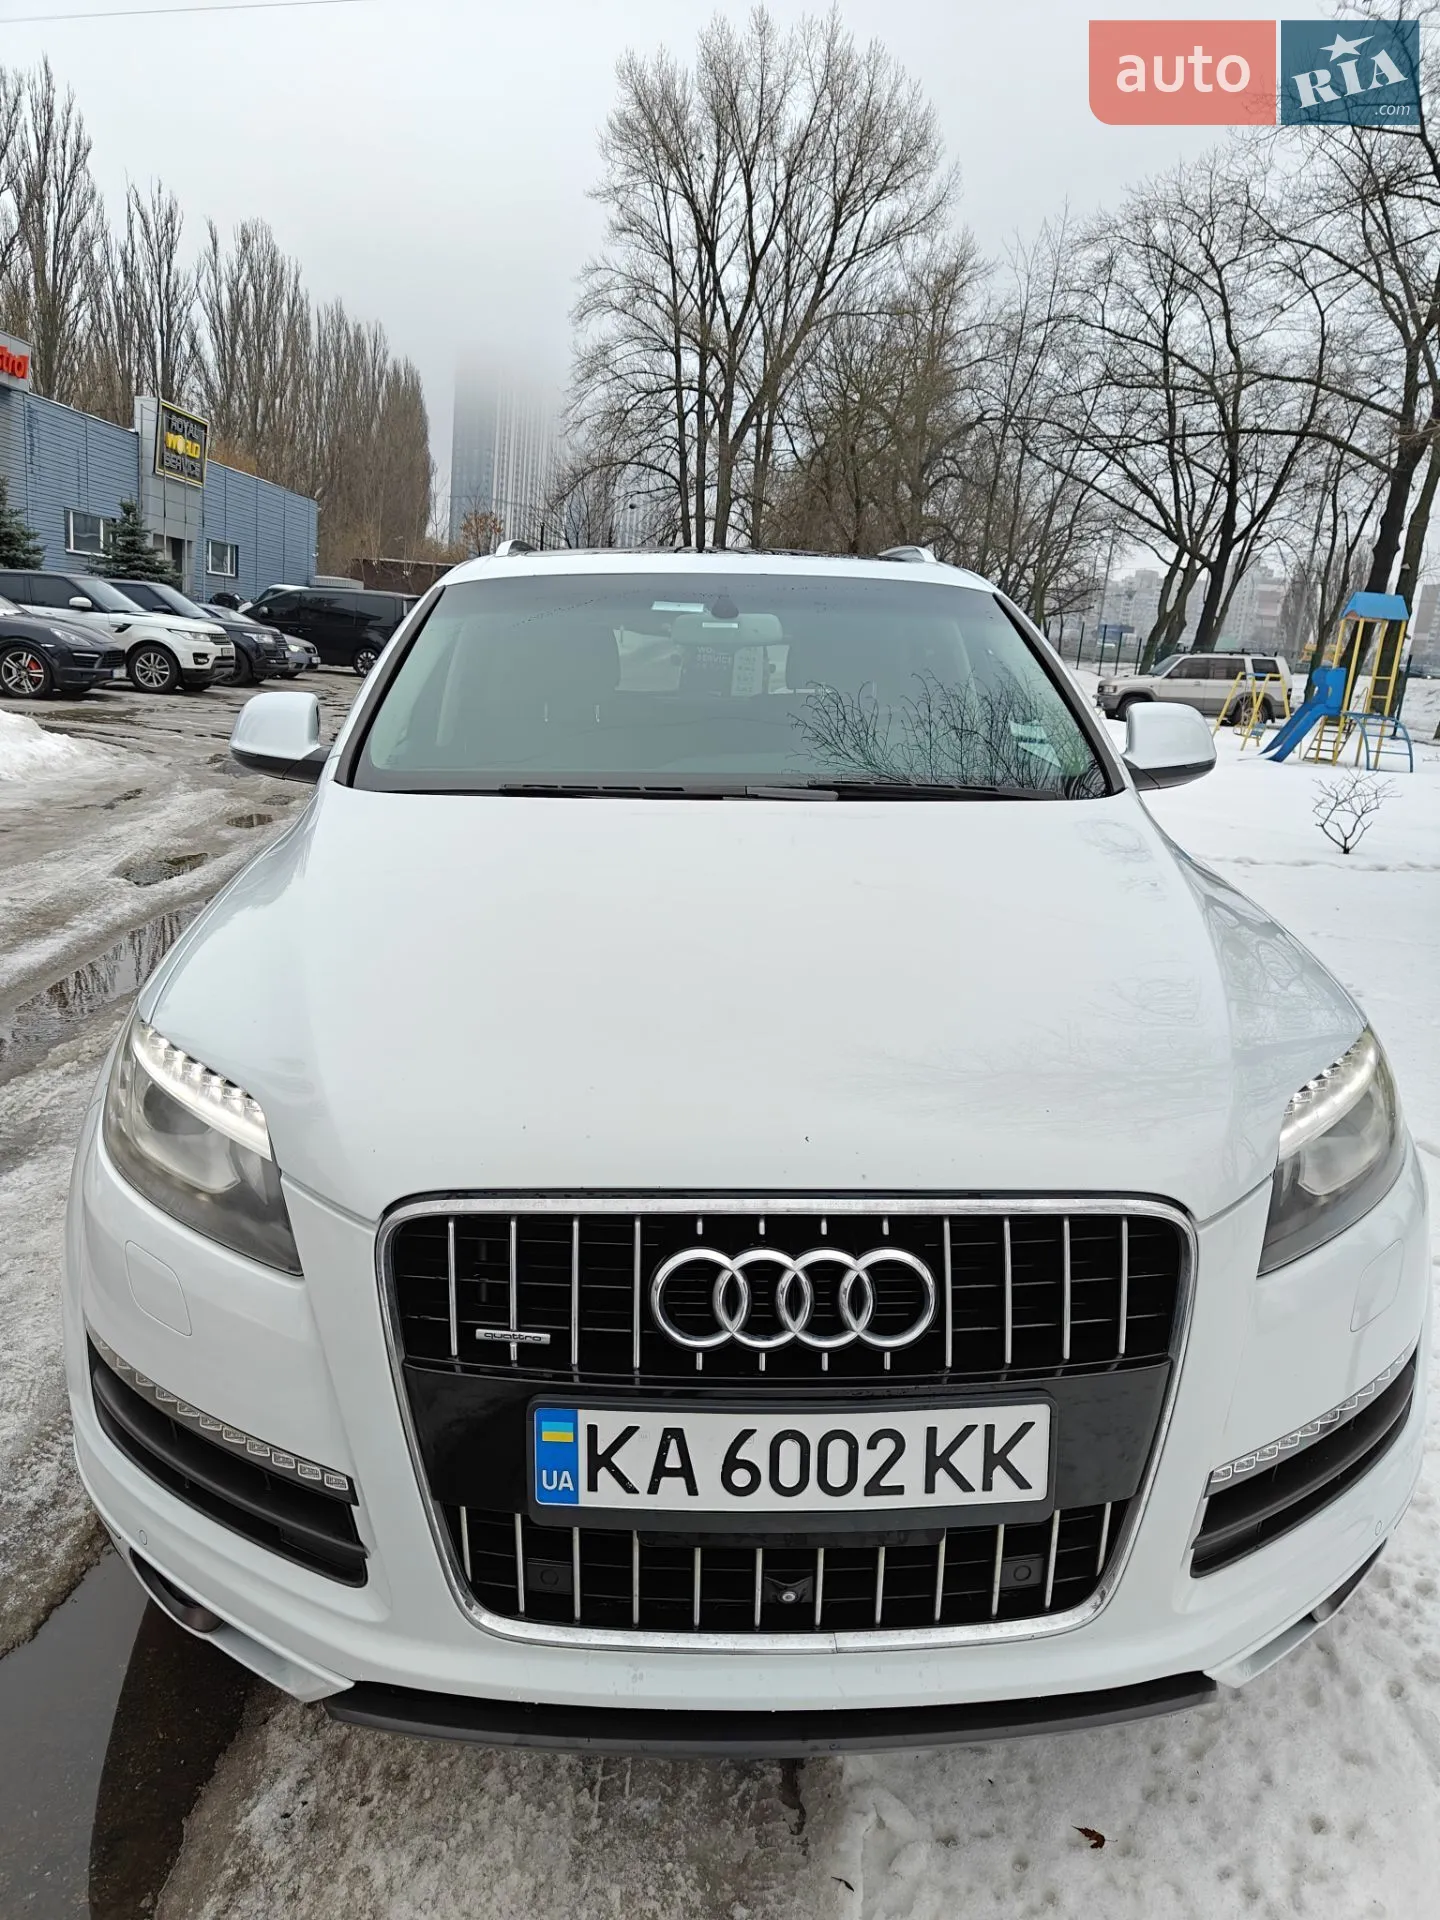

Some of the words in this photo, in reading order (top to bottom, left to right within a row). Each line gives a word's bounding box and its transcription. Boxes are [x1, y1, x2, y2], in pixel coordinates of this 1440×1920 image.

[0, 346, 28, 379] tro
[170, 414, 199, 440] ROYAL
[164, 431, 200, 459] WORLD
[164, 451, 200, 477] SERVICE
[484, 1332, 542, 1342] quattro
[585, 1423, 699, 1497] KA
[720, 1427, 906, 1498] 6002
[924, 1421, 1036, 1495] KK
[542, 1469, 575, 1492] UA
